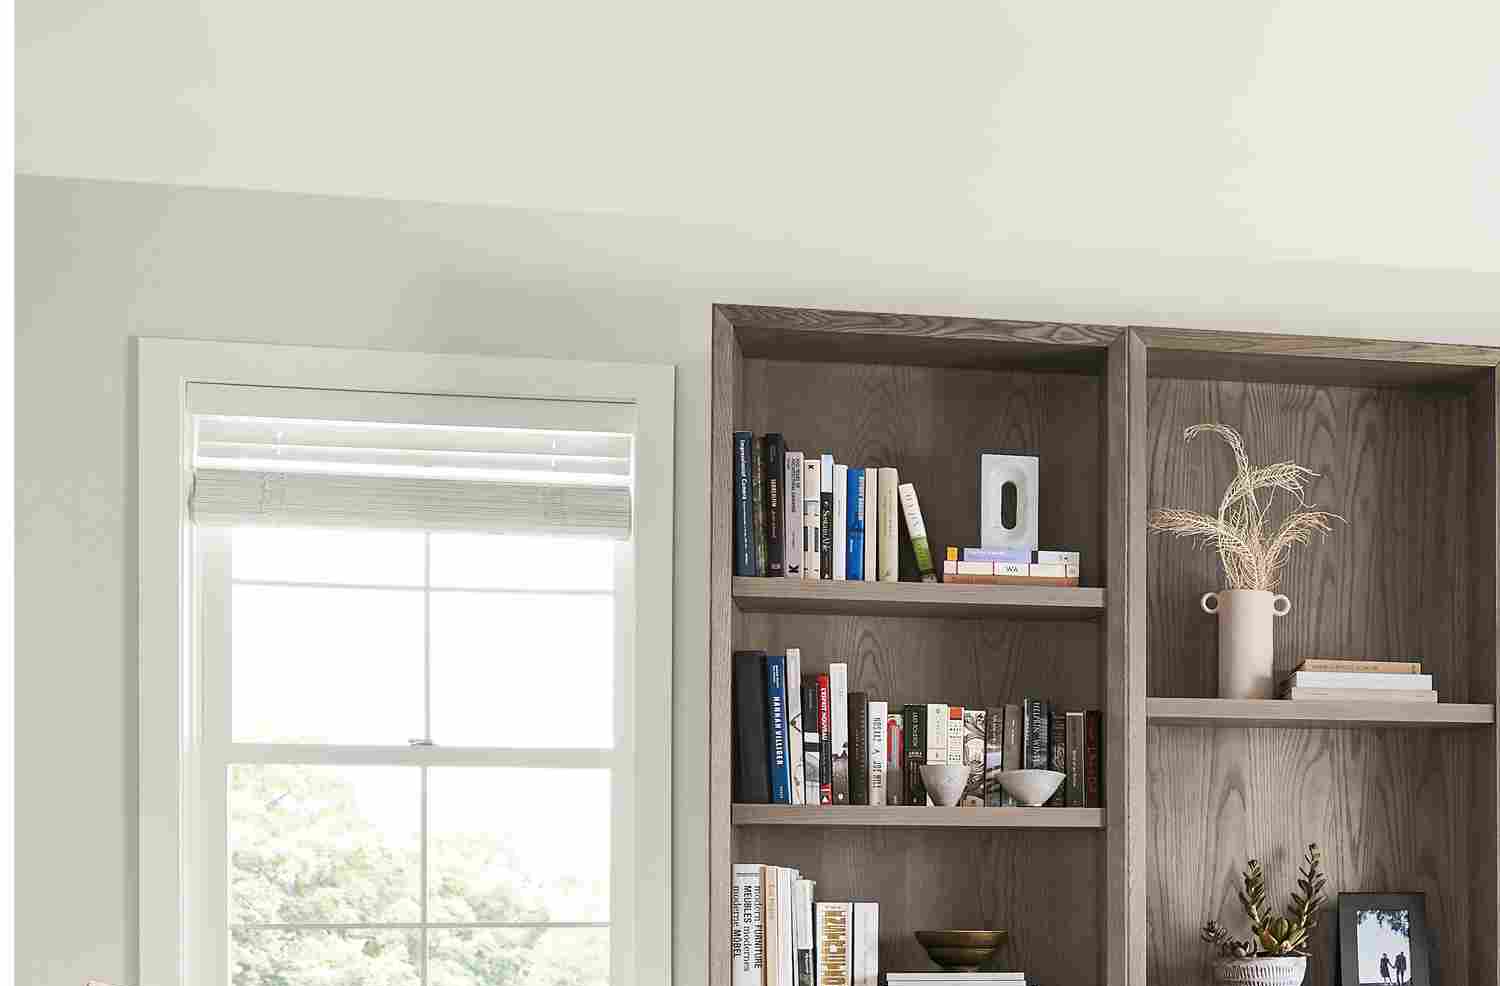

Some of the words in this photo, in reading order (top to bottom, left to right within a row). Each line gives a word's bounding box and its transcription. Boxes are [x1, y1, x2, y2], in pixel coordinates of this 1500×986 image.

[774, 730, 783, 765] VILLIGER
[743, 885, 752, 923] MEUBLES
[753, 885, 763, 922] modern
[743, 925, 752, 972] modernes
[754, 924, 763, 968] FURNITURE
